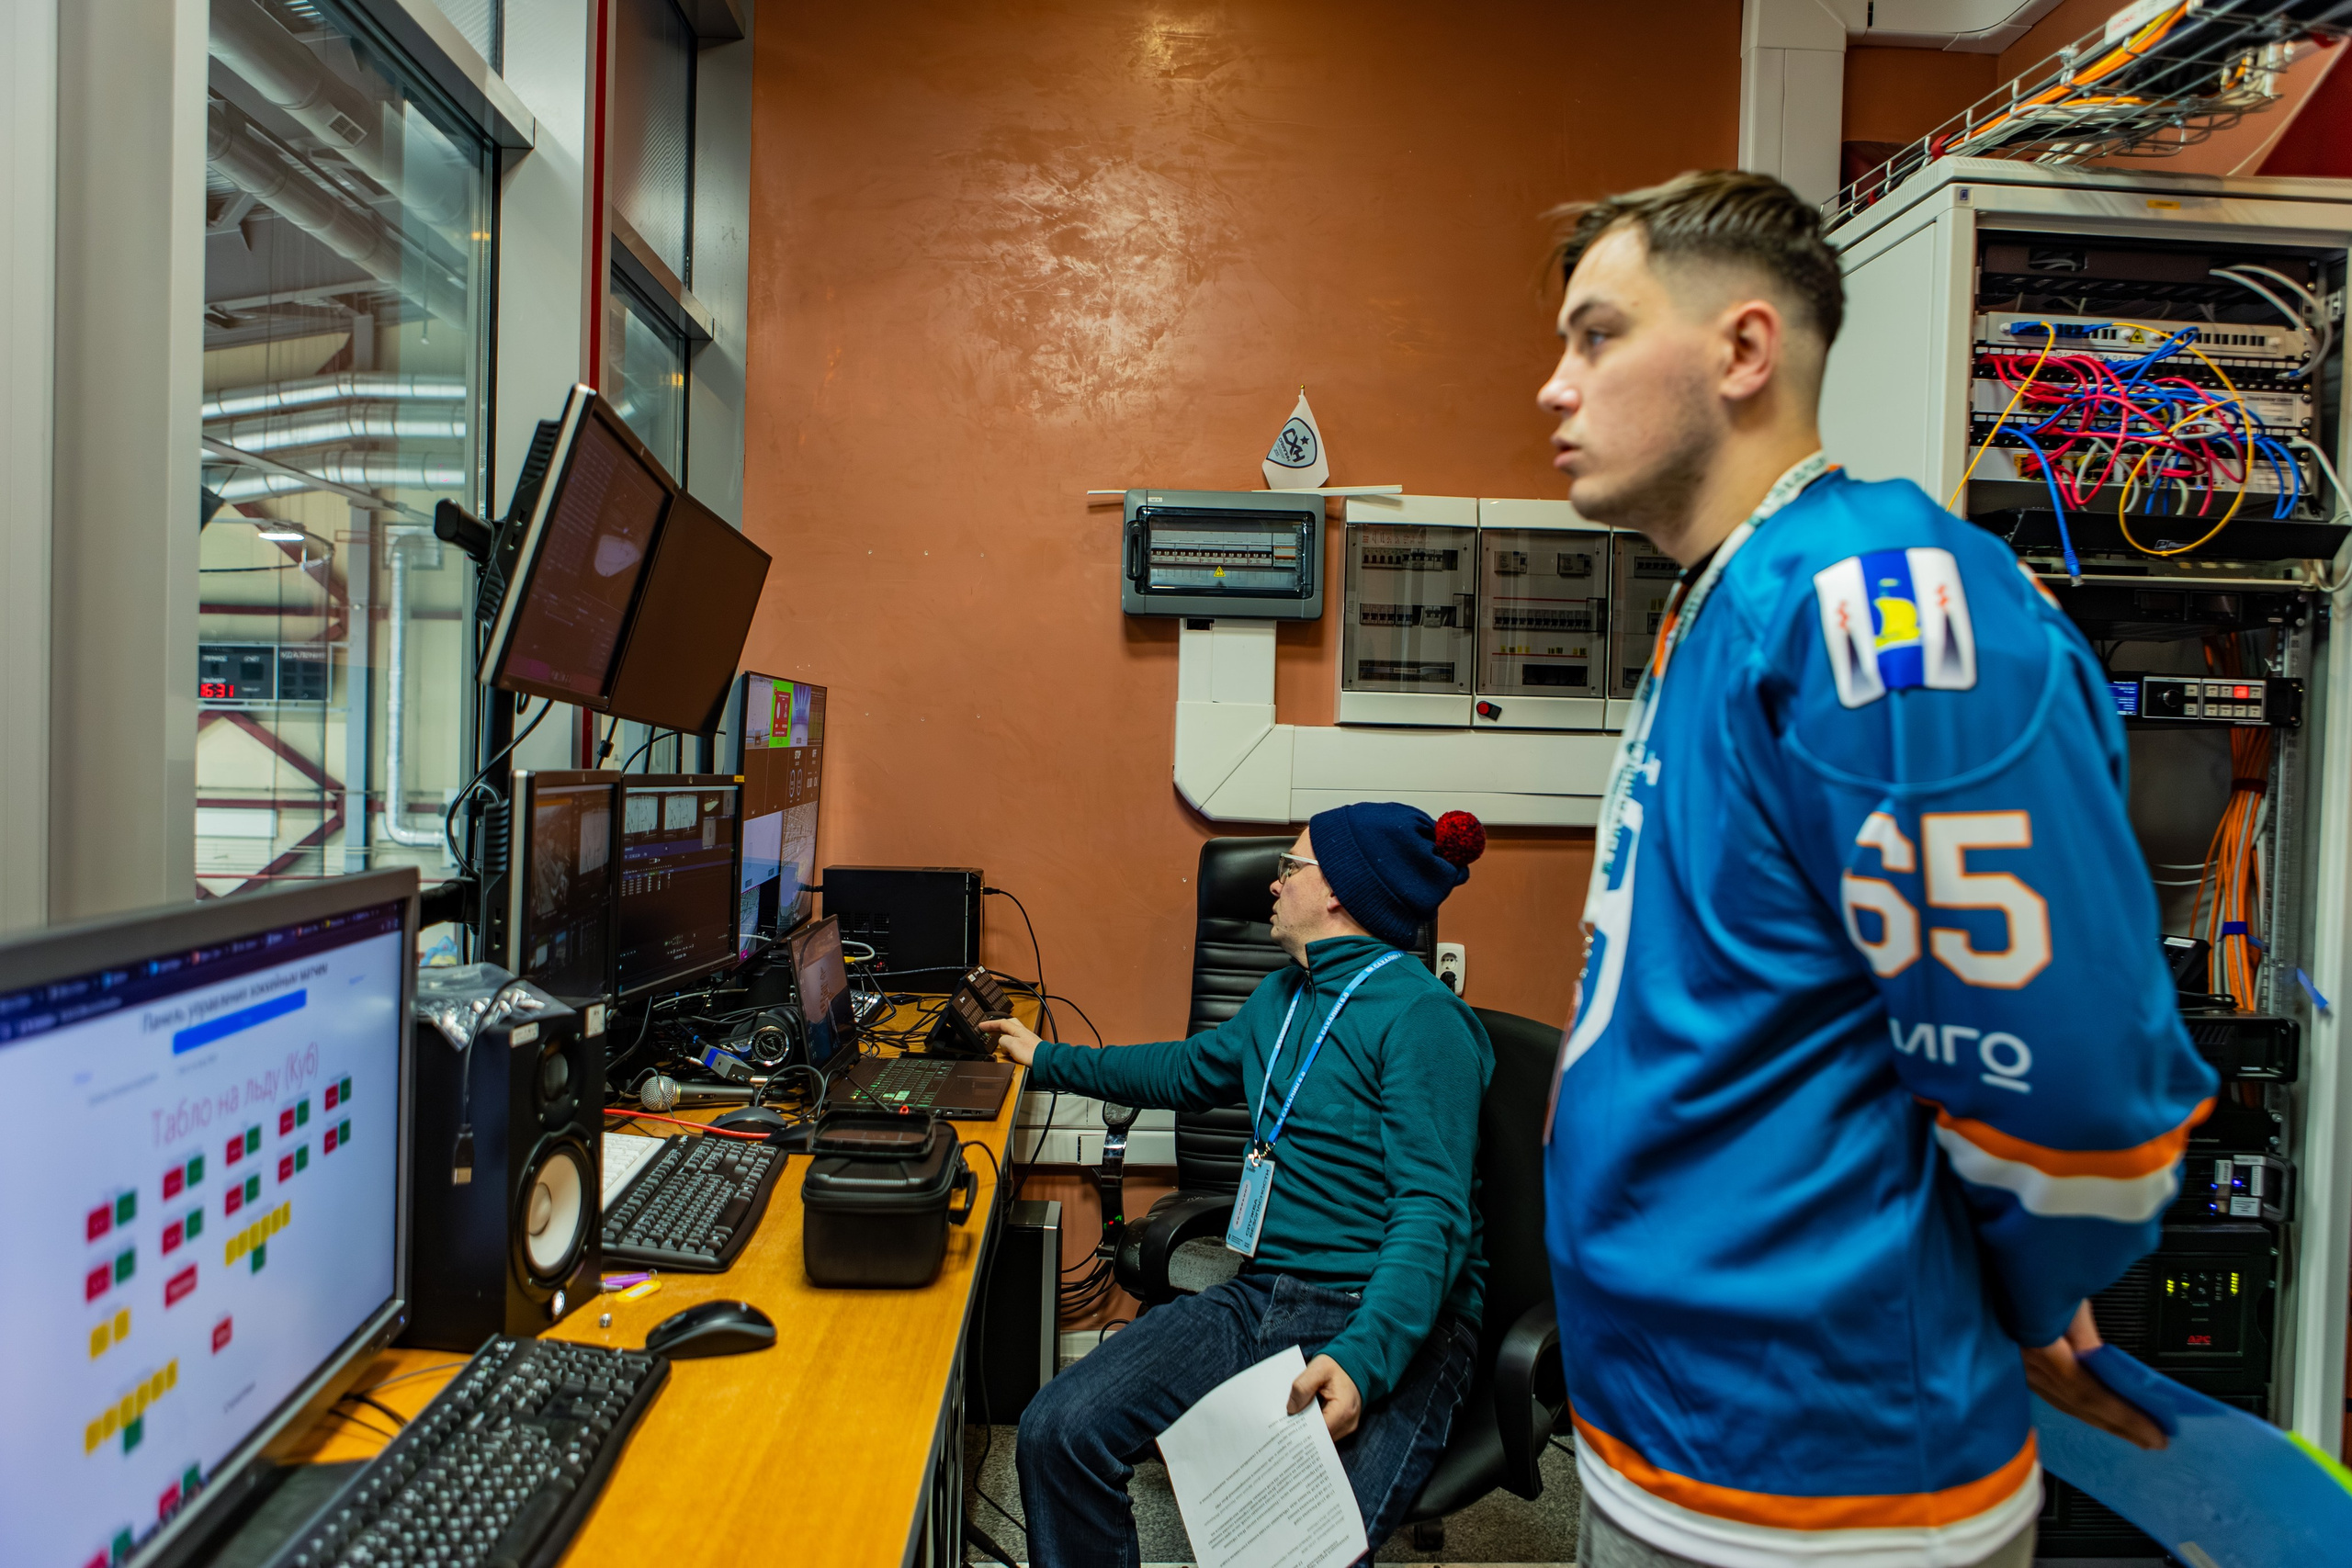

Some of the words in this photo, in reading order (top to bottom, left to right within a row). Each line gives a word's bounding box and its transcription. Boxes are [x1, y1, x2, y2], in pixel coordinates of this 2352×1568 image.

[1841, 810, 2053, 989] 65
[1321, 1002, 1342, 1035] САХАЛИН
[152, 1098, 213, 1147] Табло
[219, 1085, 240, 1118] на
[245, 1068, 281, 1106] льду
[285, 1042, 320, 1091] (Куб)
[1282, 1083, 1300, 1118] САХАЛИН
[1246, 1199, 1258, 1236] СЛУЖБА
[1250, 1168, 1270, 1238] БЕЗОПАСНОСТИ
